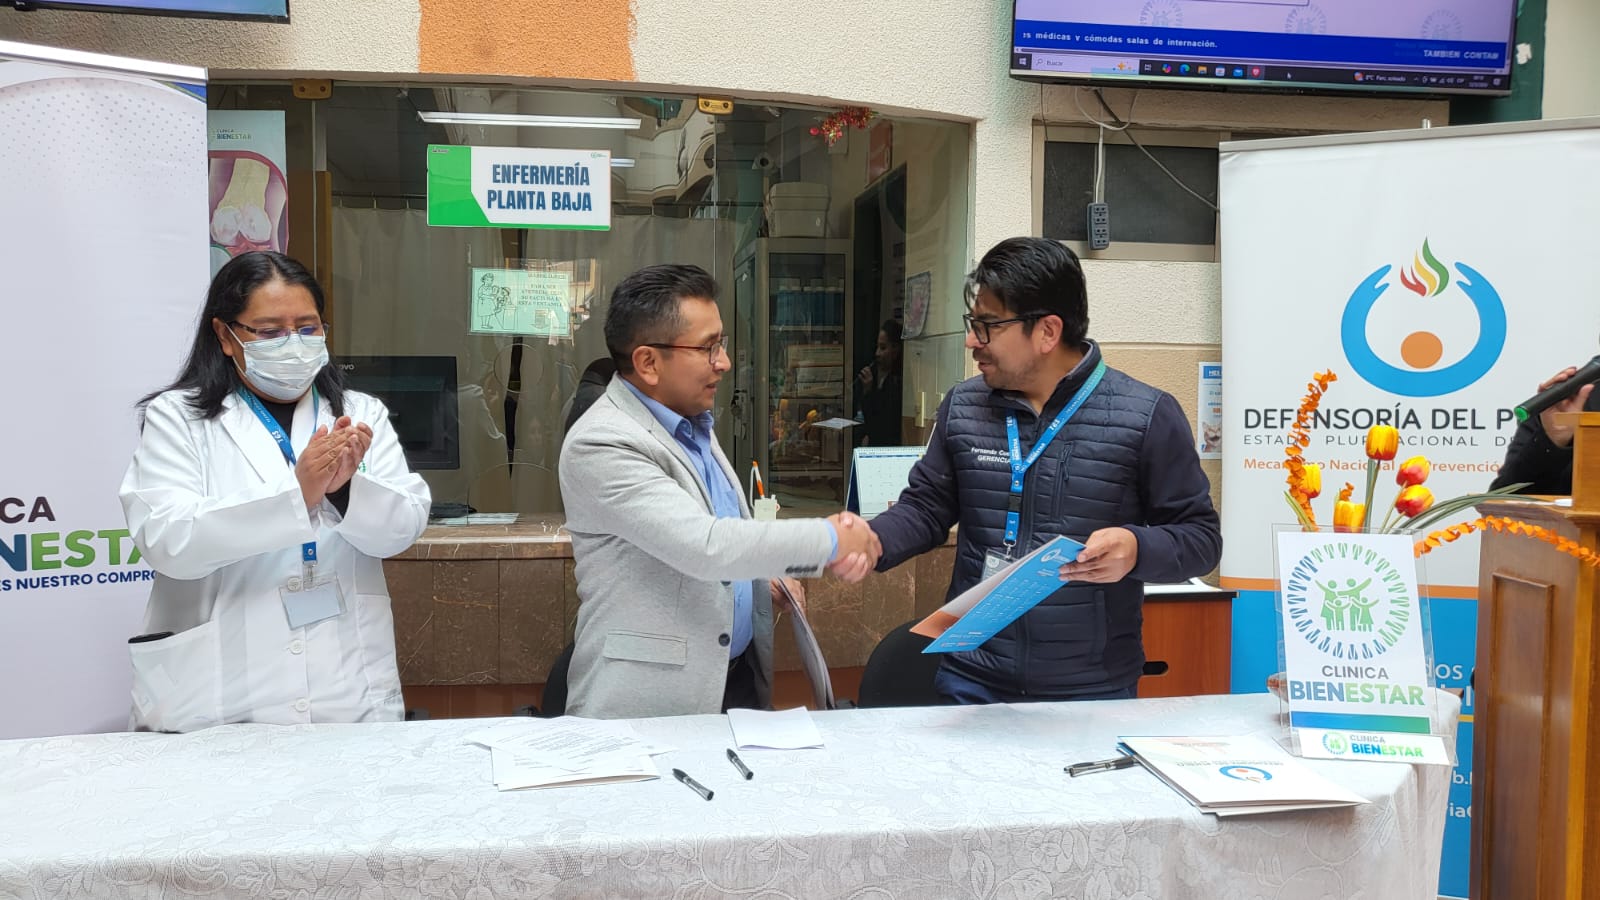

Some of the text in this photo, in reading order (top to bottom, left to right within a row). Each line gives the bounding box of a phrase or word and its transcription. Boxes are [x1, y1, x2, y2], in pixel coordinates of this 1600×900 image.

[1035, 31, 1072, 41] médicas
[1084, 34, 1123, 44] cómodas
[1126, 36, 1150, 45] salas
[1153, 38, 1164, 46] de
[1167, 38, 1218, 48] internación.
[492, 162, 590, 186] ENFERMERÍA
[487, 190, 592, 212] PLANTA BAJA
[1431, 408, 1486, 430] DEL
[1243, 434, 1310, 446] ESTAD
[1325, 435, 1479, 447] PLUACIONAL
[16, 573, 93, 590] NUESTRO
[1322, 665, 1389, 679] CLINICA
[1289, 680, 1425, 705] BIENESTAR
[1350, 734, 1386, 744] CLINICA
[1351, 743, 1424, 758] BIENESTAR
